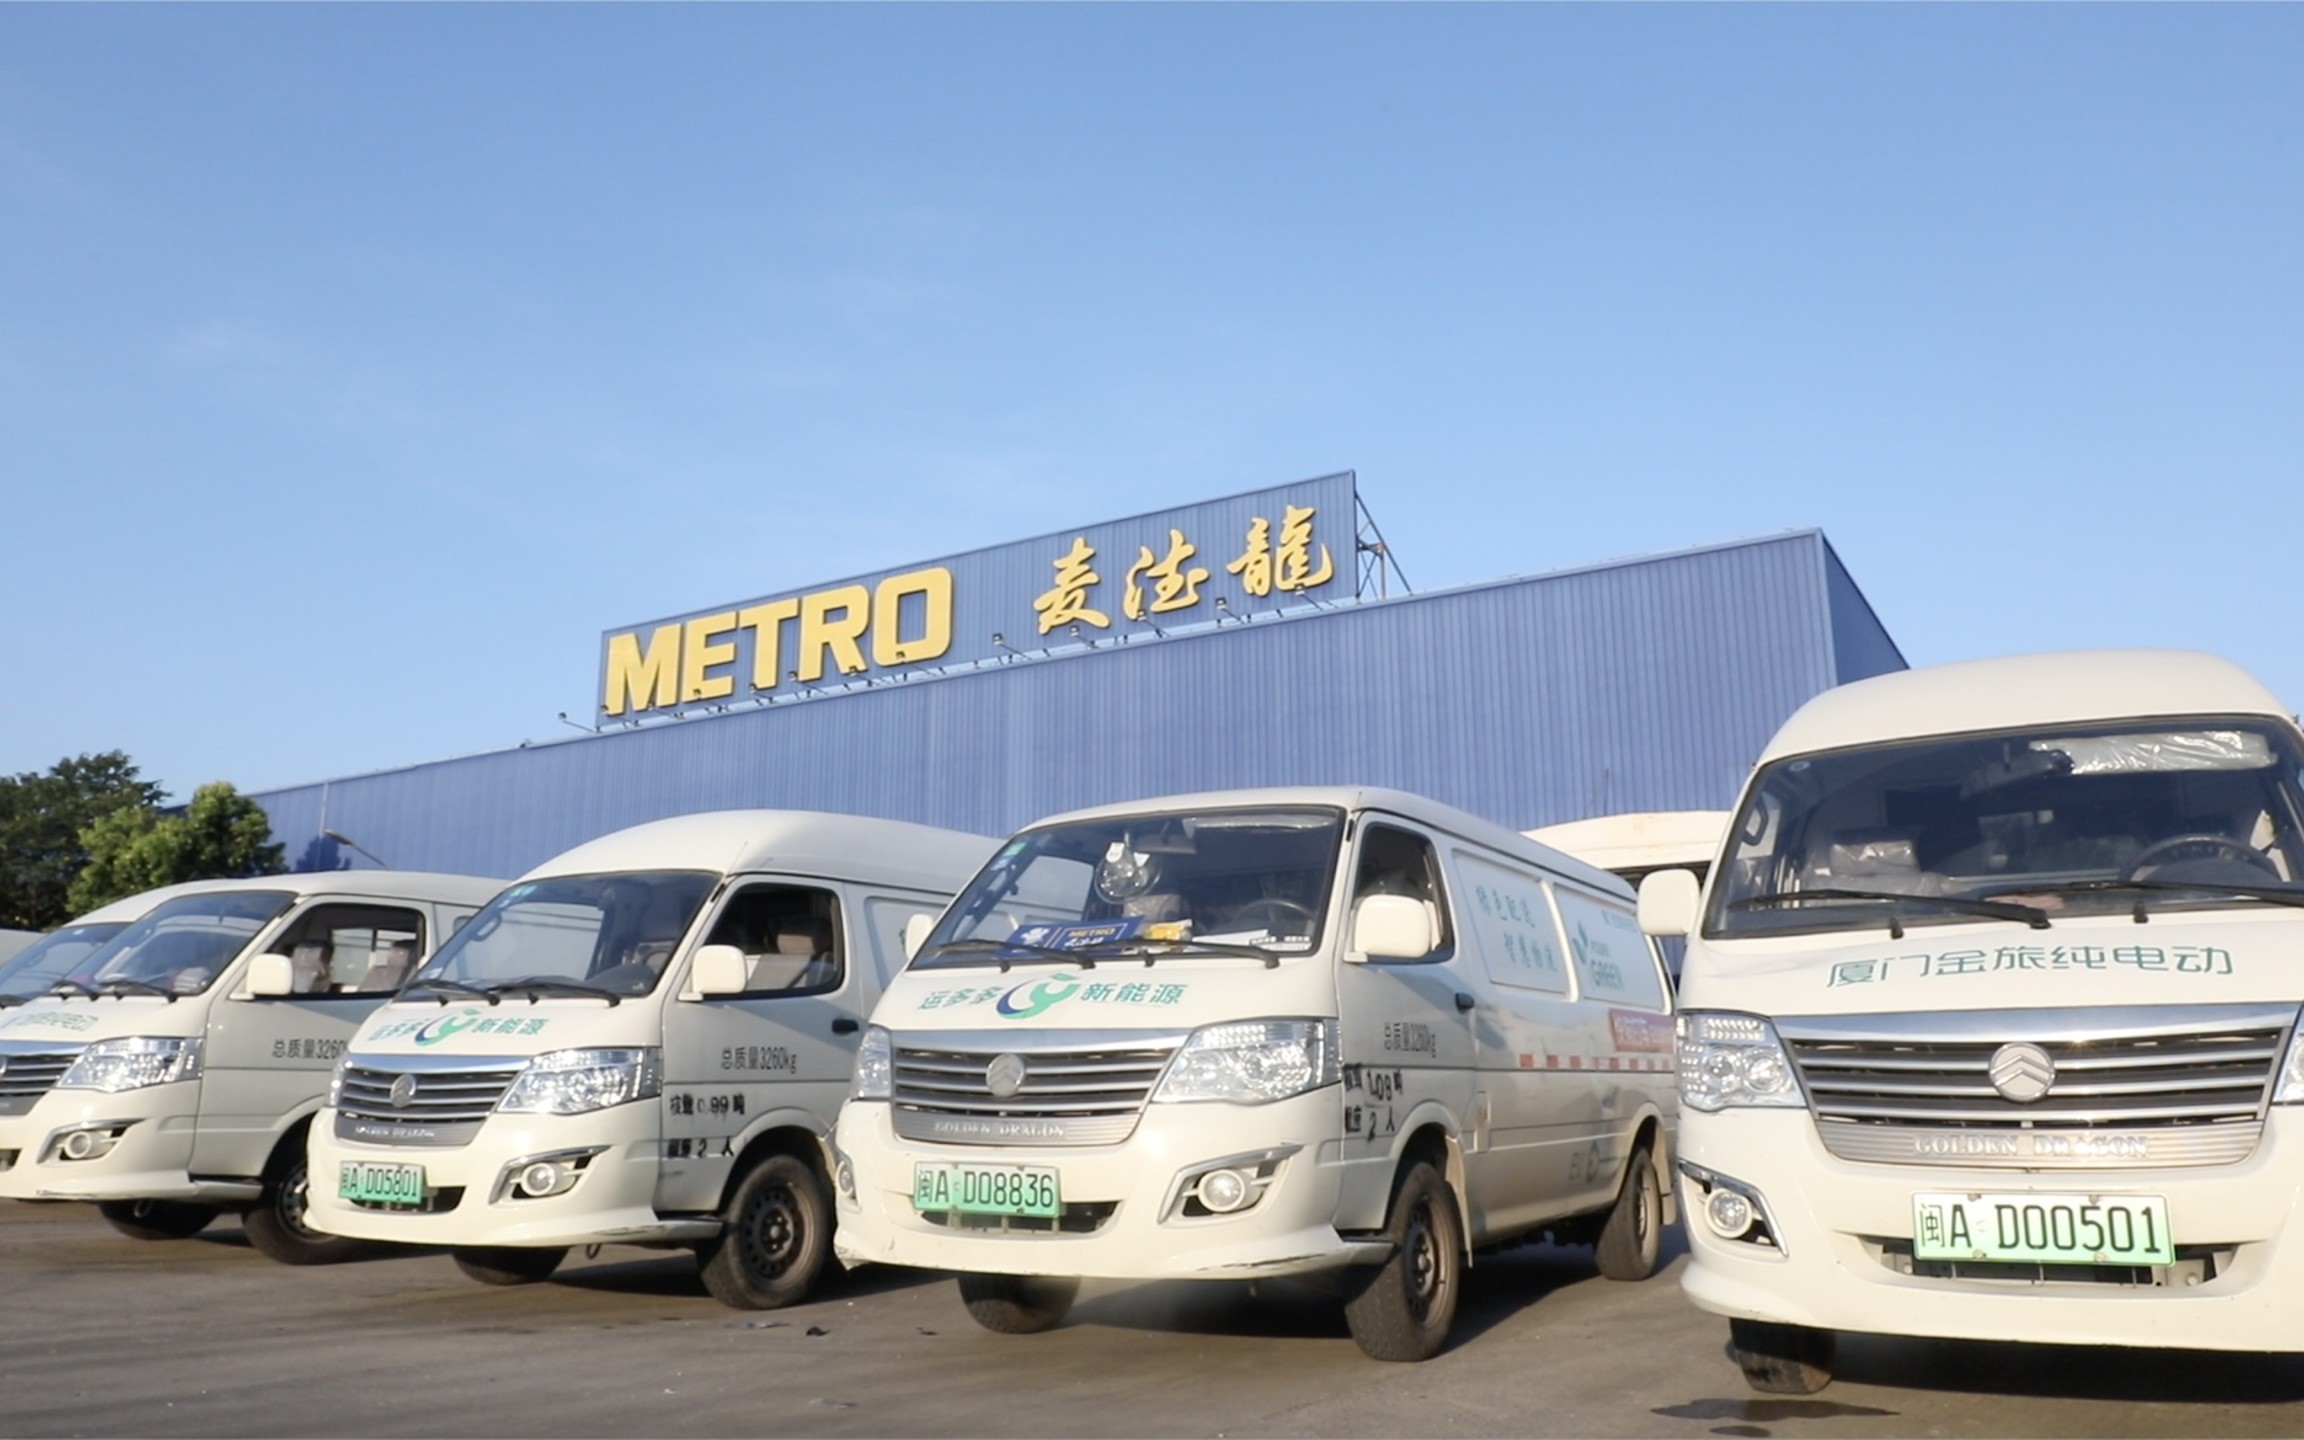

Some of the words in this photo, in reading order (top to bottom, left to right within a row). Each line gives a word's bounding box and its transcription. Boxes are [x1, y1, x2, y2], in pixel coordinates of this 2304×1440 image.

[604, 567, 952, 716] METRO
[1827, 945, 2233, 987] 厦门金旅纯电动
[1080, 983, 1187, 1005] 新能源
[1914, 1135, 2018, 1155] GOLDEN
[2033, 1135, 2150, 1157] DRAGON
[963, 1170, 1054, 1208] D08836
[1920, 1203, 1972, 1249] 闽A
[1995, 1203, 2161, 1253] D00501
